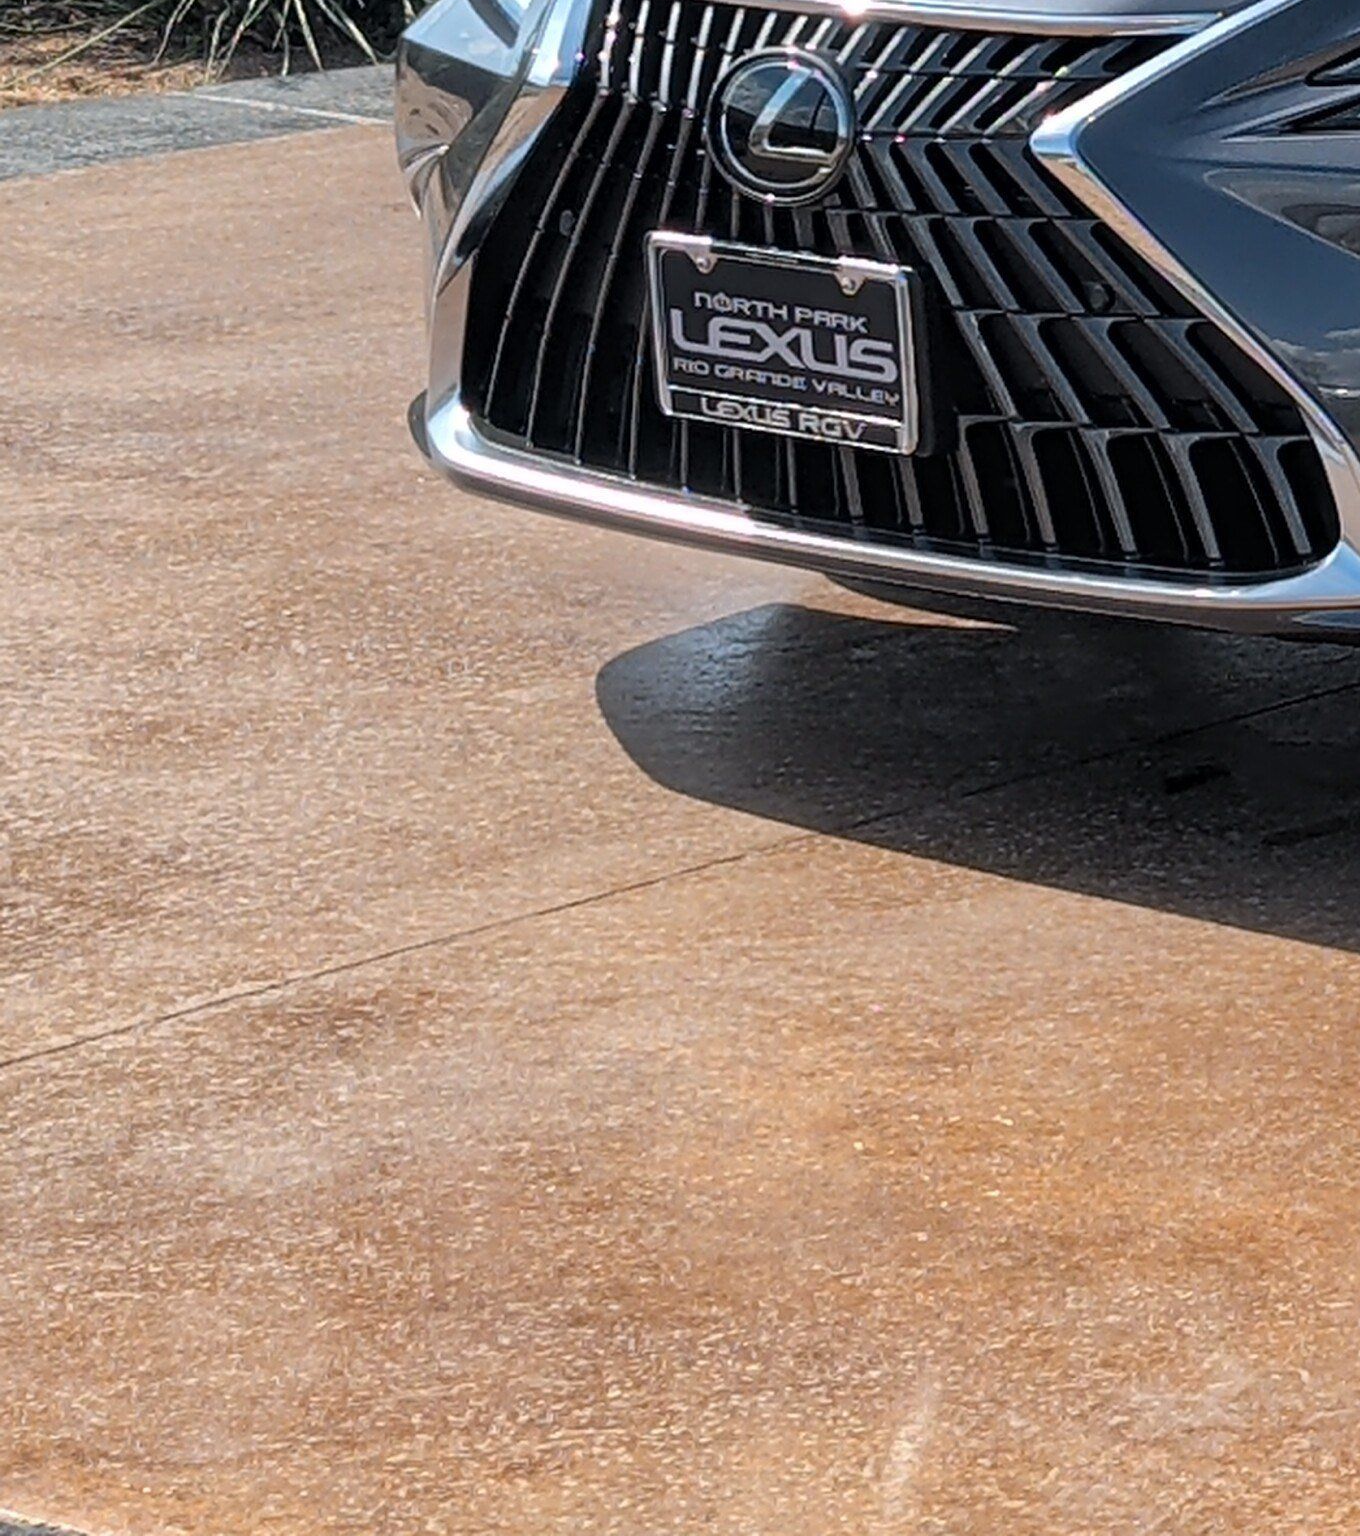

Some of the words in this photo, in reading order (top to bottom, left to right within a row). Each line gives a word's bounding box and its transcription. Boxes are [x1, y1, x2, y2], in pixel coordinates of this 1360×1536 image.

[694, 291, 788, 321] NORTH
[794, 306, 868, 333] PARK
[669, 308, 898, 384] LEXUS
[672, 357, 709, 378] RIO
[714, 363, 808, 390] GRANDE
[811, 378, 900, 407] VALLEY
[701, 397, 791, 429] LEXUS
[798, 413, 868, 441] RGV
